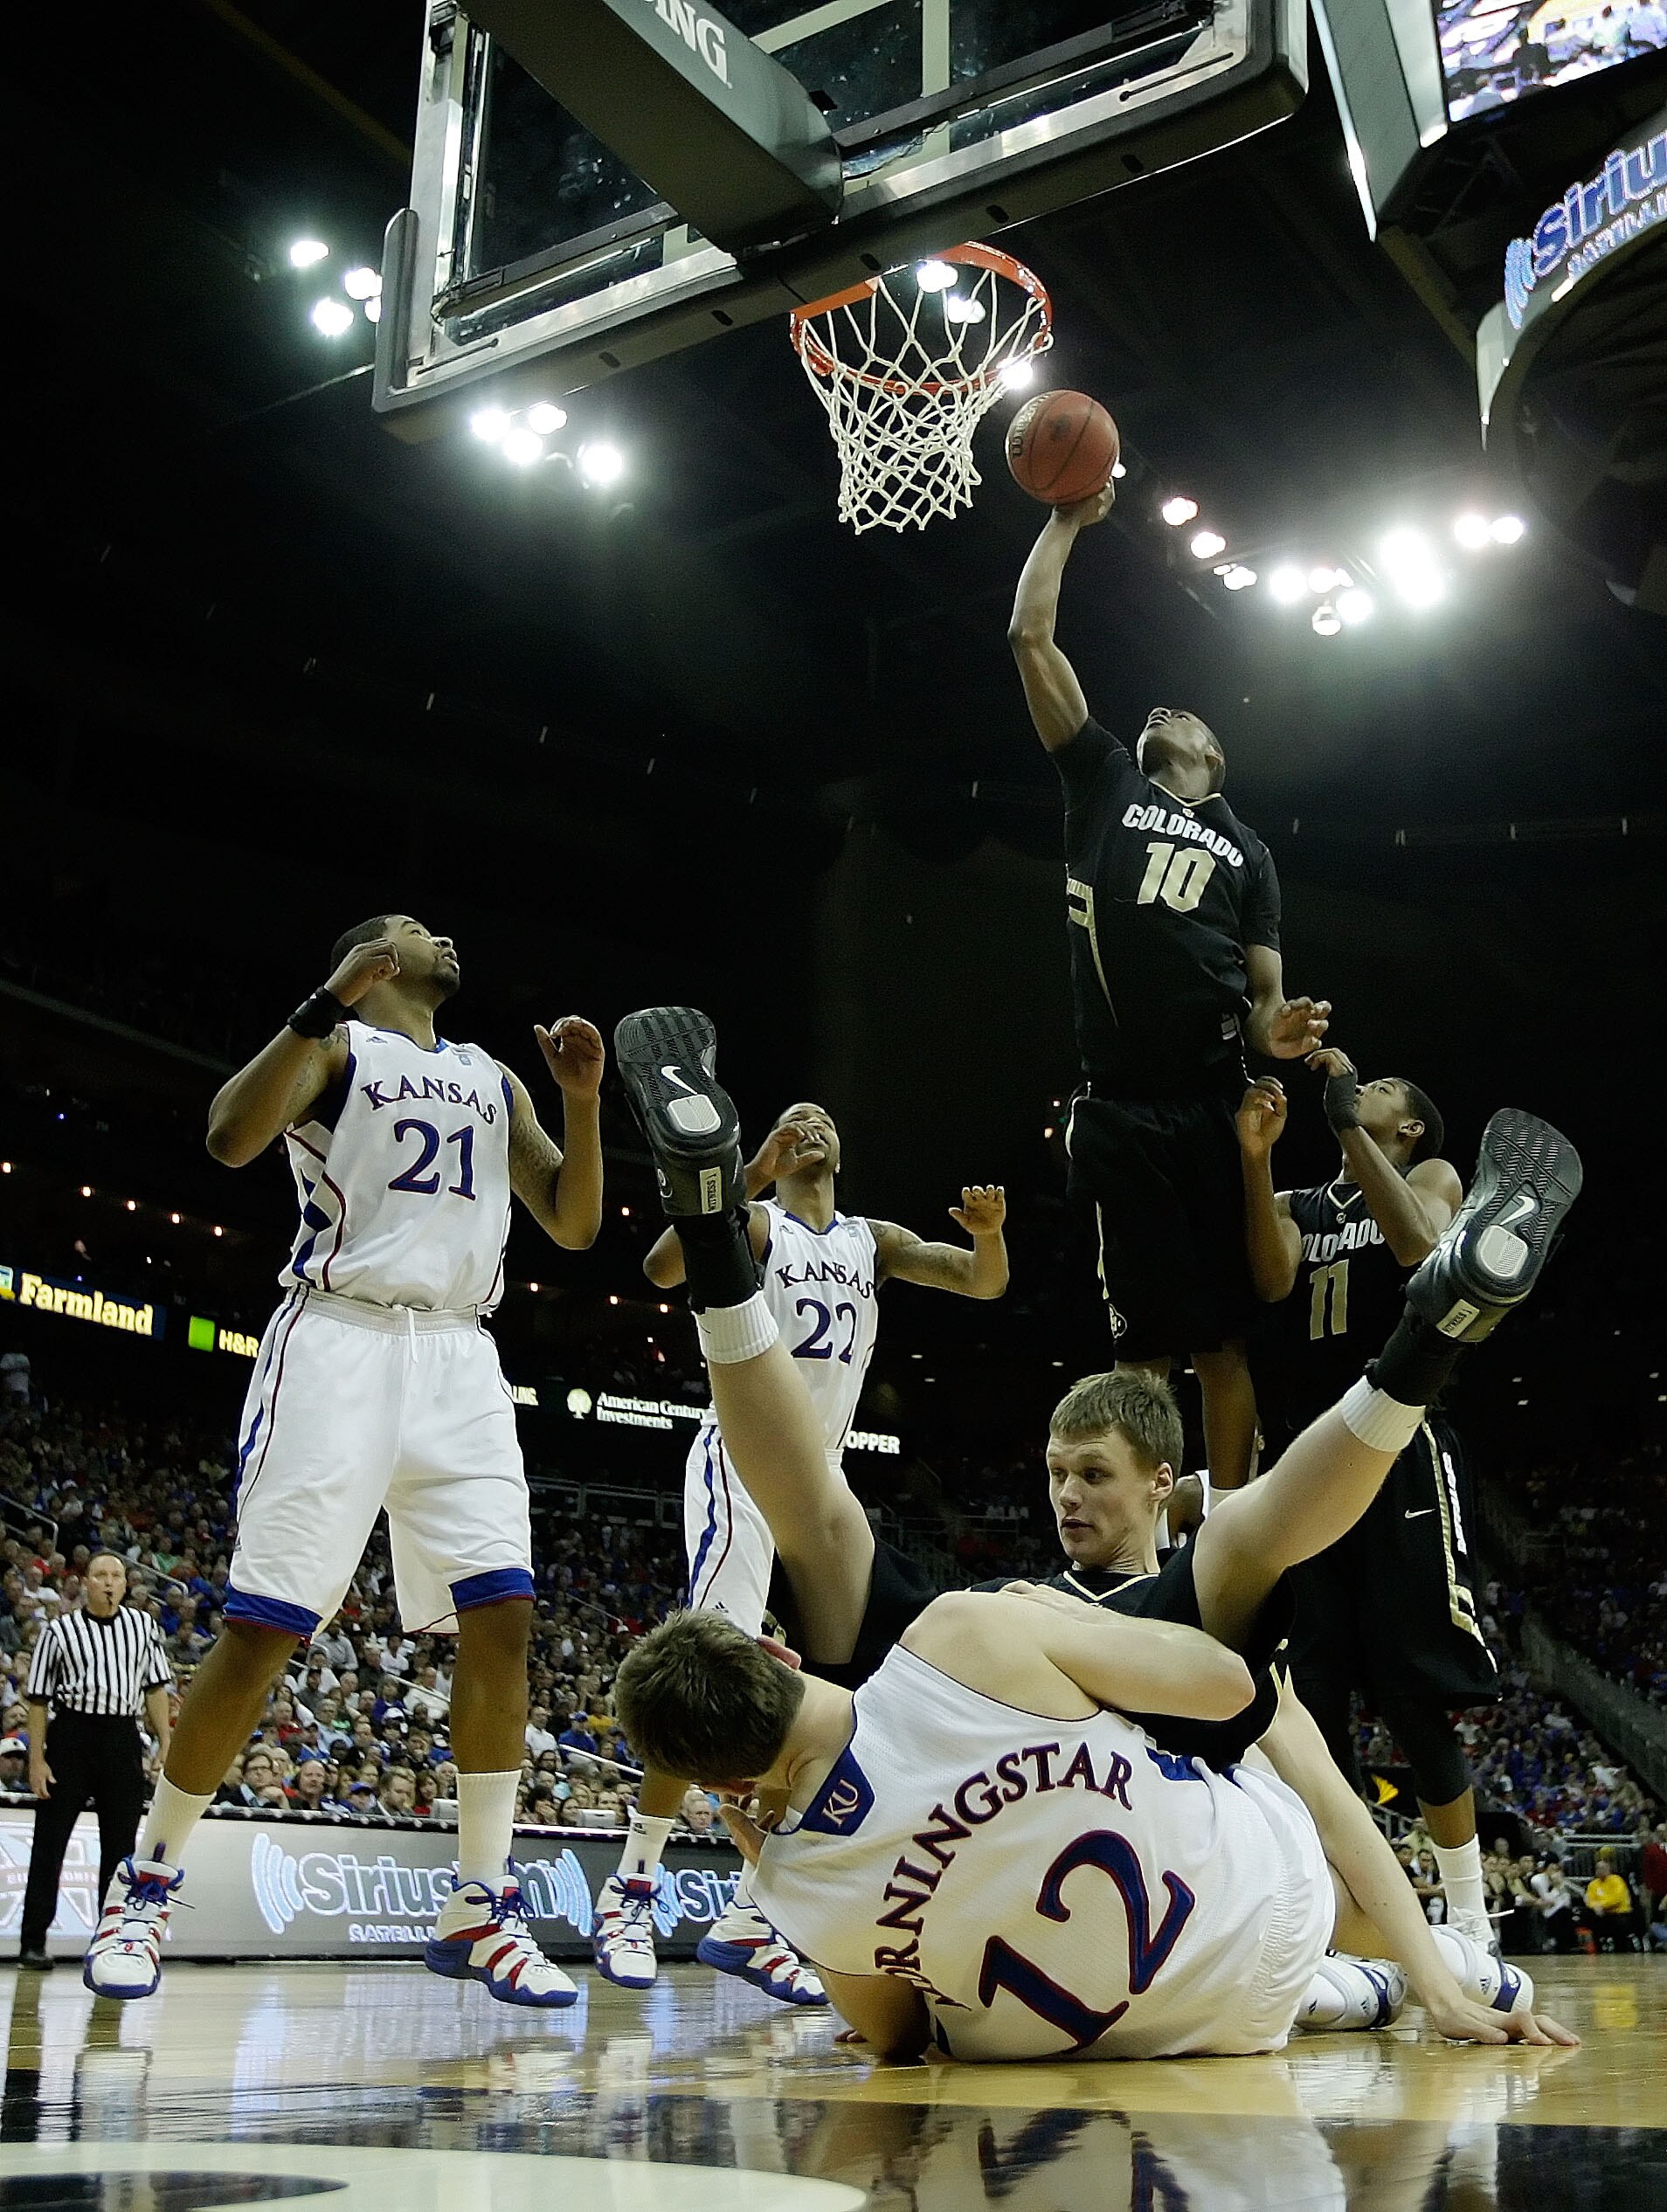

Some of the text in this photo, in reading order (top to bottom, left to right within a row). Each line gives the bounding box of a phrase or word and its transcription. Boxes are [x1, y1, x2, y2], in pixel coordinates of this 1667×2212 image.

[1122, 803, 1244, 868] COLORADO
[1137, 842, 1216, 913] 10
[361, 1074, 497, 1125] KANSAS
[388, 1118, 477, 1201] 21
[19, 1272, 153, 1336] Farmland
[775, 1261, 874, 1299] KANSAS
[1310, 1259, 1350, 1341] 11
[218, 1329, 259, 1358] H&R
[597, 1392, 660, 1414] American
[597, 1406, 674, 1430] Investments
[822, 1779, 860, 1828] KU
[978, 1828, 1195, 2046] 12
